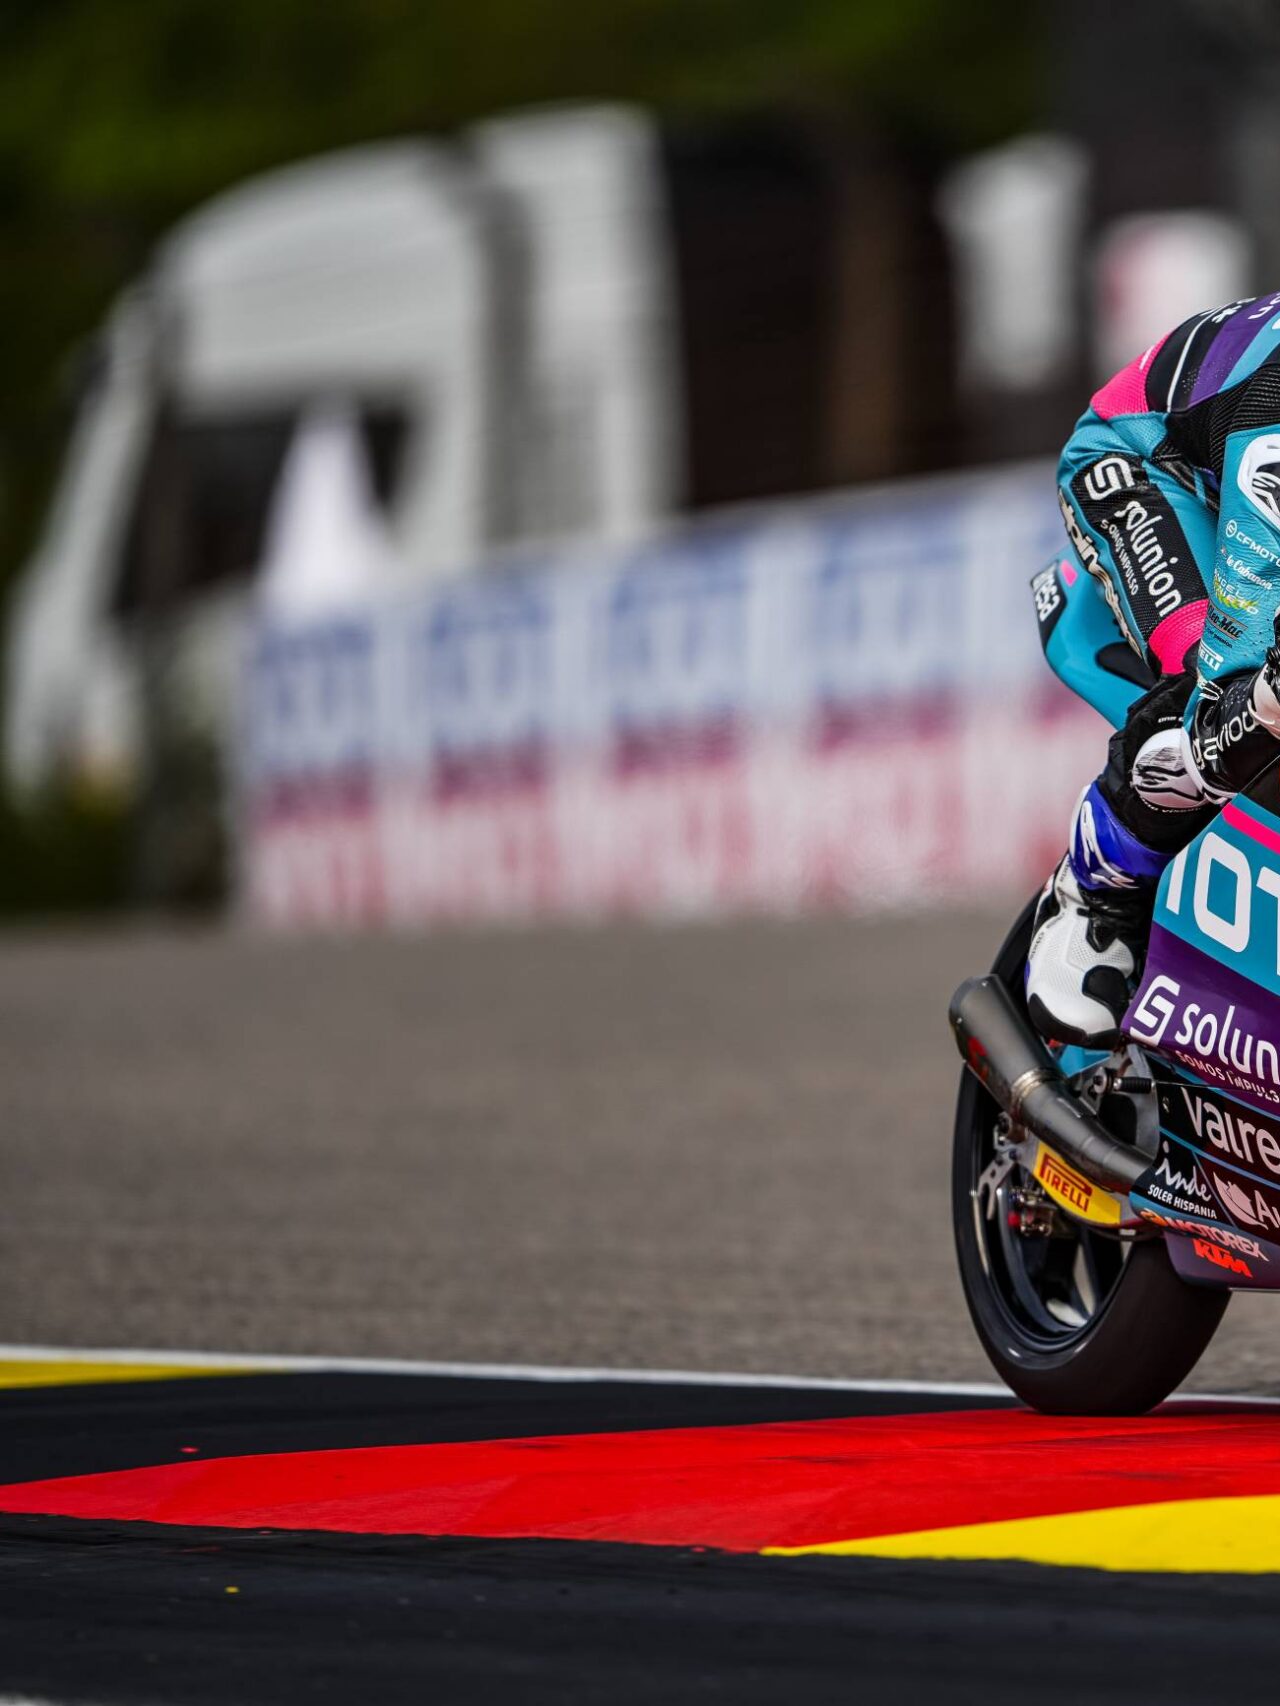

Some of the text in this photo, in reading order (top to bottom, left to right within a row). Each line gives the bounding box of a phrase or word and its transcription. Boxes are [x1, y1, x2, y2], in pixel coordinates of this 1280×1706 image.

[1114, 500, 1182, 617] solunion
[1038, 1152, 1093, 1212] PIRELLI
[1147, 1183, 1217, 1219] SOLER HISPANIA
